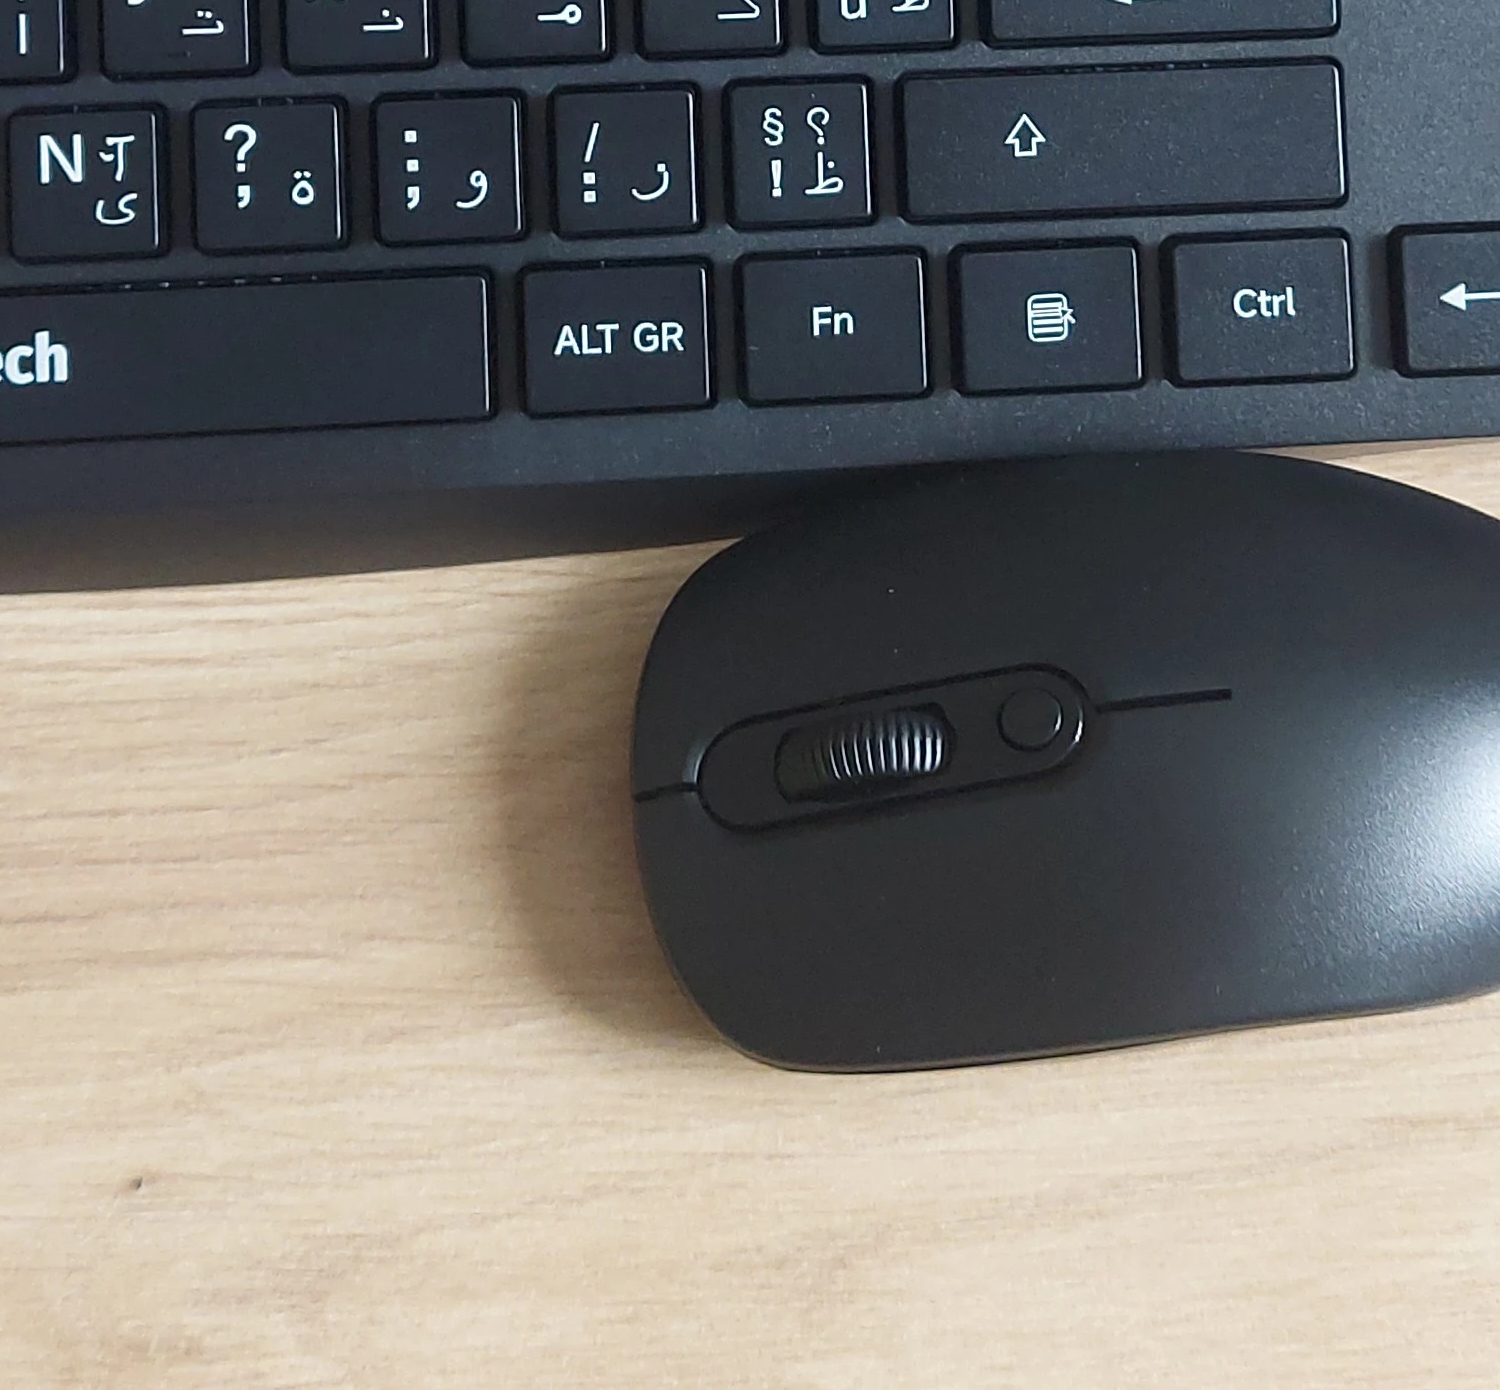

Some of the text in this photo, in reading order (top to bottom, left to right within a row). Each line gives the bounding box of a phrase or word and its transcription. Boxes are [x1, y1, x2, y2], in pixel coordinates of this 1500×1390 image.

[39, 133, 83, 184] N
[1233, 286, 1296, 319] Ctrl
[812, 305, 854, 337] Fn
[553, 321, 684, 356] ALT GR
